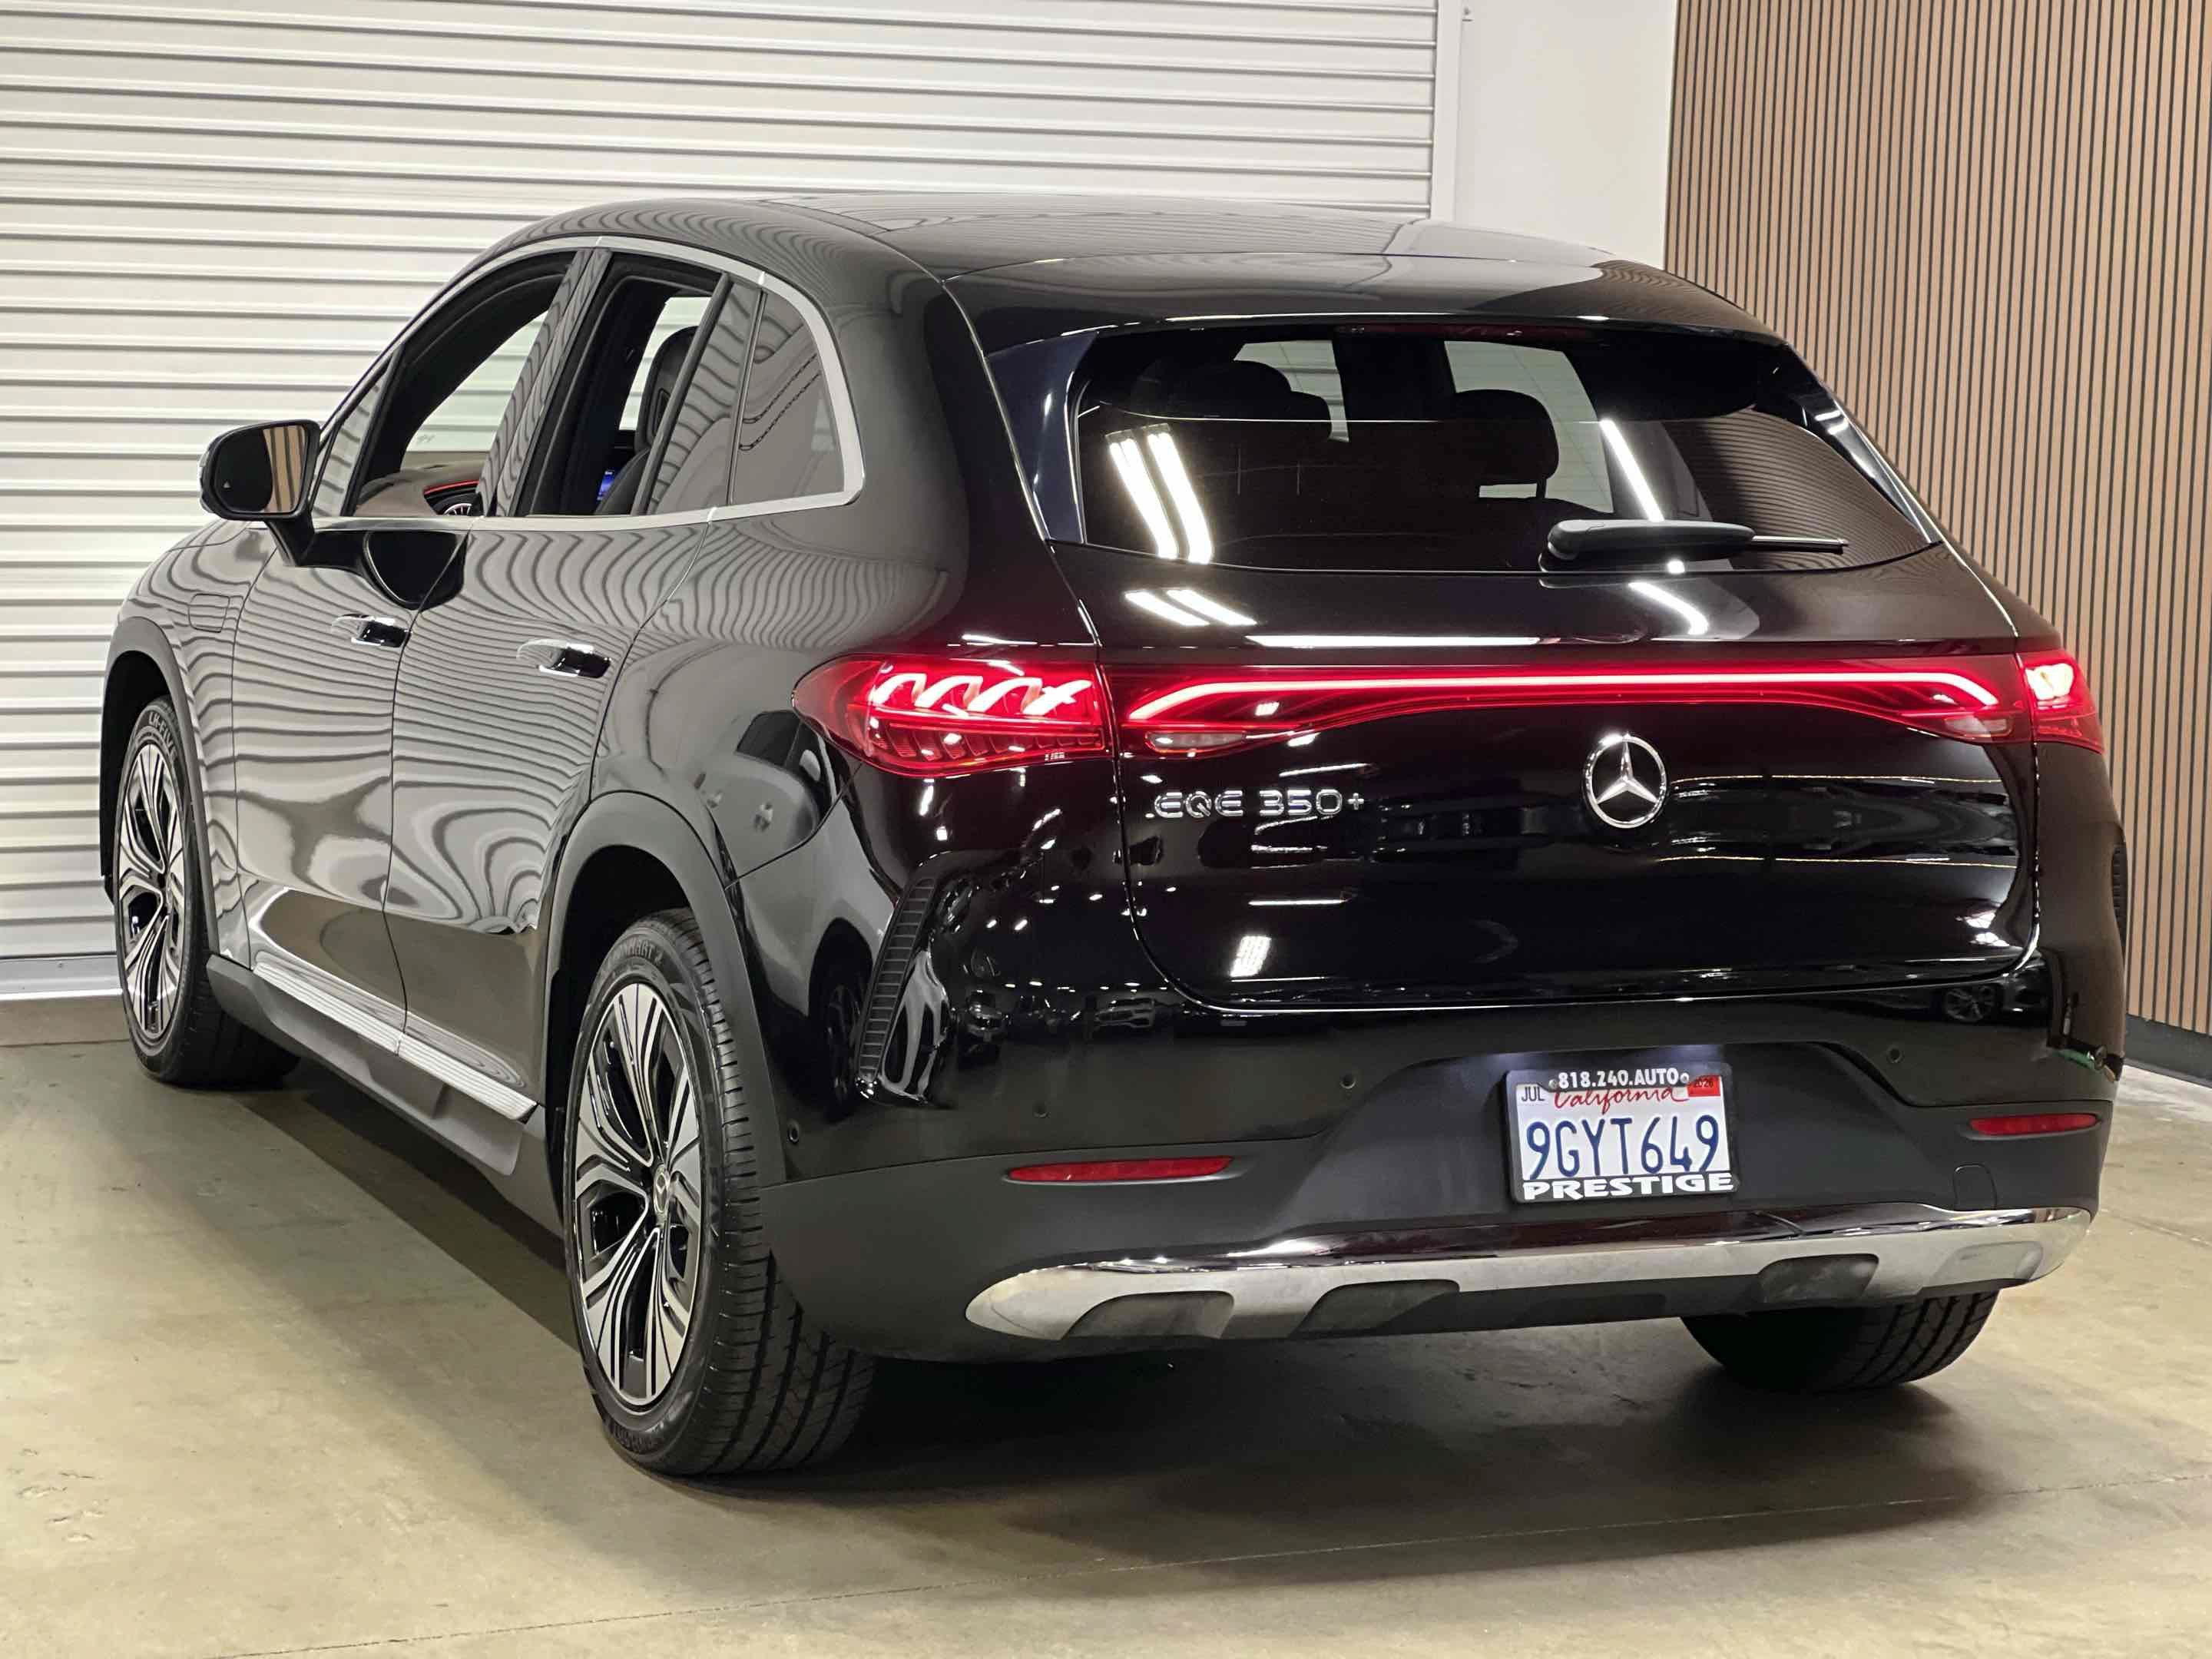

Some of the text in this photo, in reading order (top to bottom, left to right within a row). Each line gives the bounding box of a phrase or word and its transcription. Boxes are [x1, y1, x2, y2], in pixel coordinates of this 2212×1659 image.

[1154, 789, 1364, 818] EQE 350+
[1558, 1068, 1678, 1088] 818.240.AUTO
[1521, 1087, 1545, 1101] JUL
[1554, 1087, 1690, 1115] California
[1526, 1114, 1719, 1180] 9GYT649
[1522, 1173, 1734, 1200] PRESTIGE
